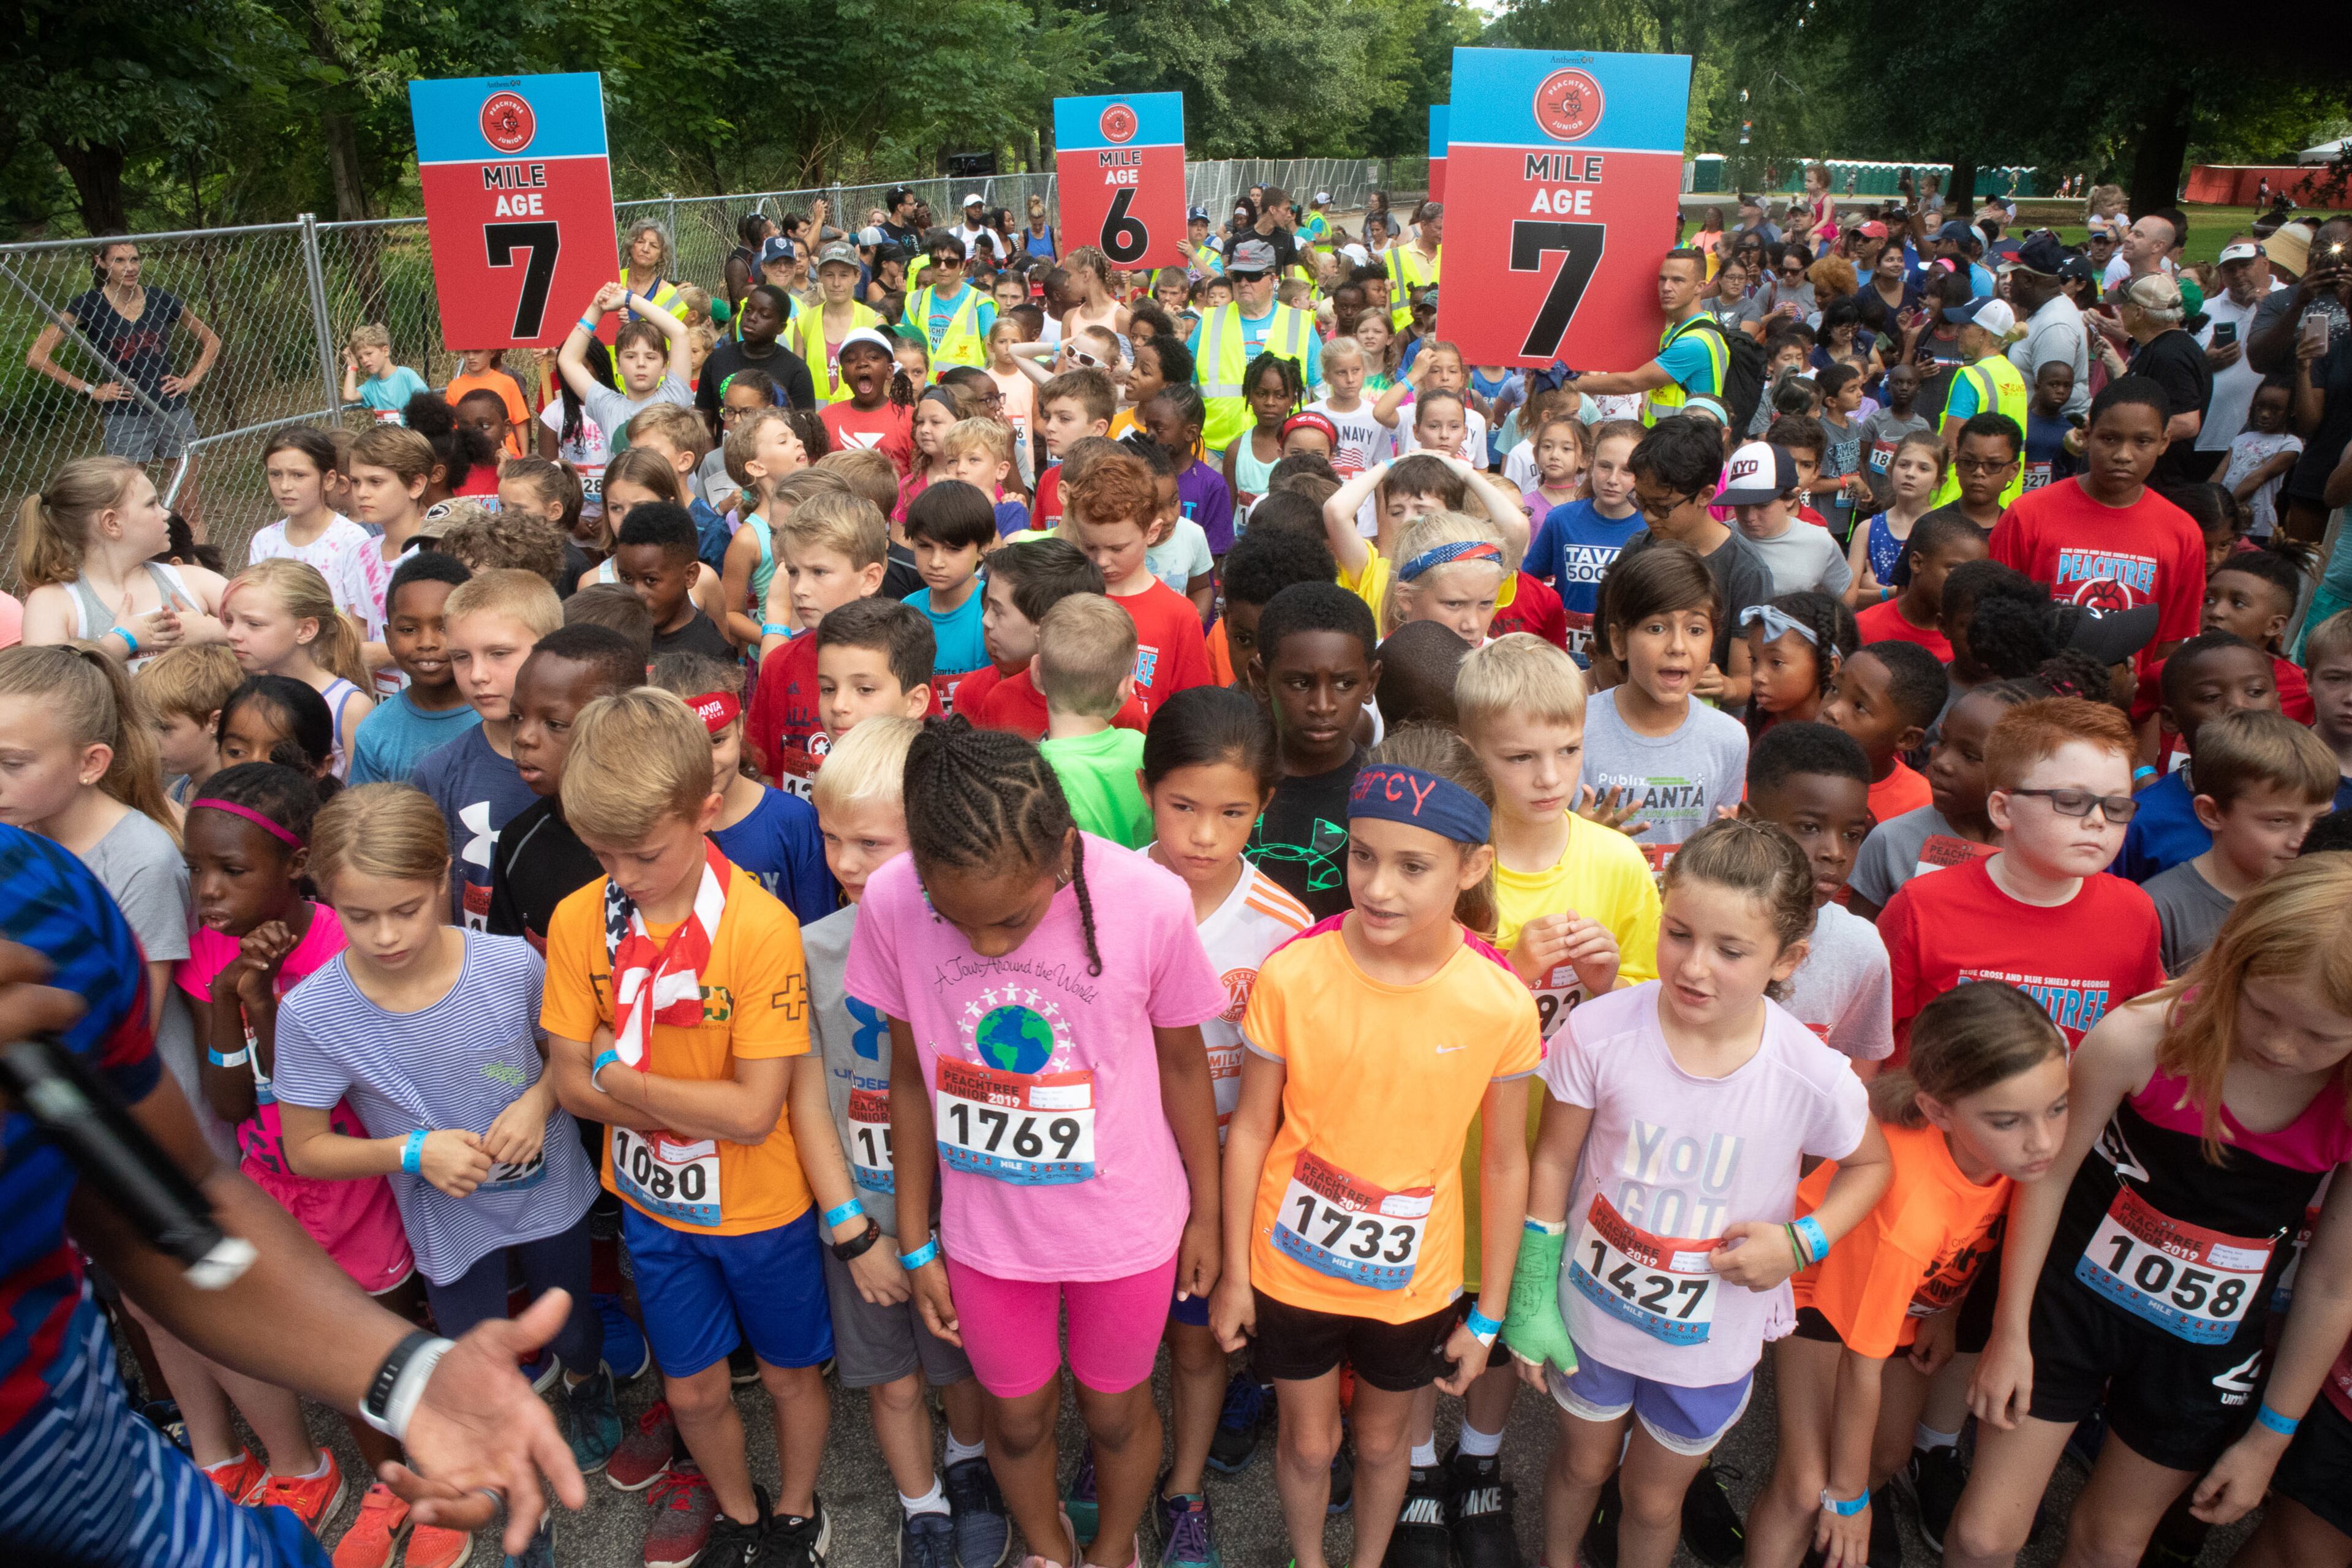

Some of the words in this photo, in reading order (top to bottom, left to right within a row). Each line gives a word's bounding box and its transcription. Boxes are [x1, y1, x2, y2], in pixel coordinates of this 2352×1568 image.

[1548, 79, 1591, 96] PEACHTREE
[489, 101, 524, 116] PEACHTREE
[1552, 120, 1583, 130] JUNIOR
[497, 134, 522, 145] JUNIOR
[1099, 150, 1142, 167] MILE
[1525, 153, 1604, 183] MILE
[483, 164, 547, 190] MILE
[1105, 170, 1138, 184] AGE
[495, 194, 544, 217] AGE
[1530, 188, 1593, 215] AGE
[1099, 187, 1149, 264] 6
[483, 221, 561, 339] 7
[1509, 219, 1606, 358] 7
[1341, 425, 1373, 445] NAVY
[1731, 459, 1758, 475] NYO
[2056, 554, 2156, 595] PEACHTREE
[946, 956, 982, 981] Tour
[980, 957, 1032, 978] Around
[1035, 962, 1052, 981] the
[1050, 964, 1098, 1005] World
[1979, 970, 2003, 979] CROSS
[2024, 974, 2043, 983] BLUE
[2044, 976, 2069, 986] SHIELD
[2082, 979, 2110, 988] GEORGIA
[943, 1070, 1019, 1096] PEACHTREE
[950, 1102, 1080, 1159] 1769
[617, 1131, 706, 1201] 1080
[1000, 1160, 1023, 1170] MILE
[1624, 1119, 1746, 1195] YOU
[1302, 1162, 1373, 1206] PEACHTREE
[643, 1193, 658, 1205] MILE
[1616, 1181, 1727, 1241] GOT
[1296, 1195, 1415, 1264] 1733
[1596, 1209, 1660, 1257] PEACHTREE
[2120, 1202, 2204, 1252] PEACHTREE
[1332, 1257, 1354, 1270] MILE
[2109, 1234, 2247, 1318] 1058
[1591, 1240, 1709, 1319] 1427
[1623, 1303, 1644, 1318] MILE
[2147, 1300, 2173, 1316] MILE
[1401, 1498, 1446, 1524] NIKE
[1460, 1487, 1502, 1518] NIKE
